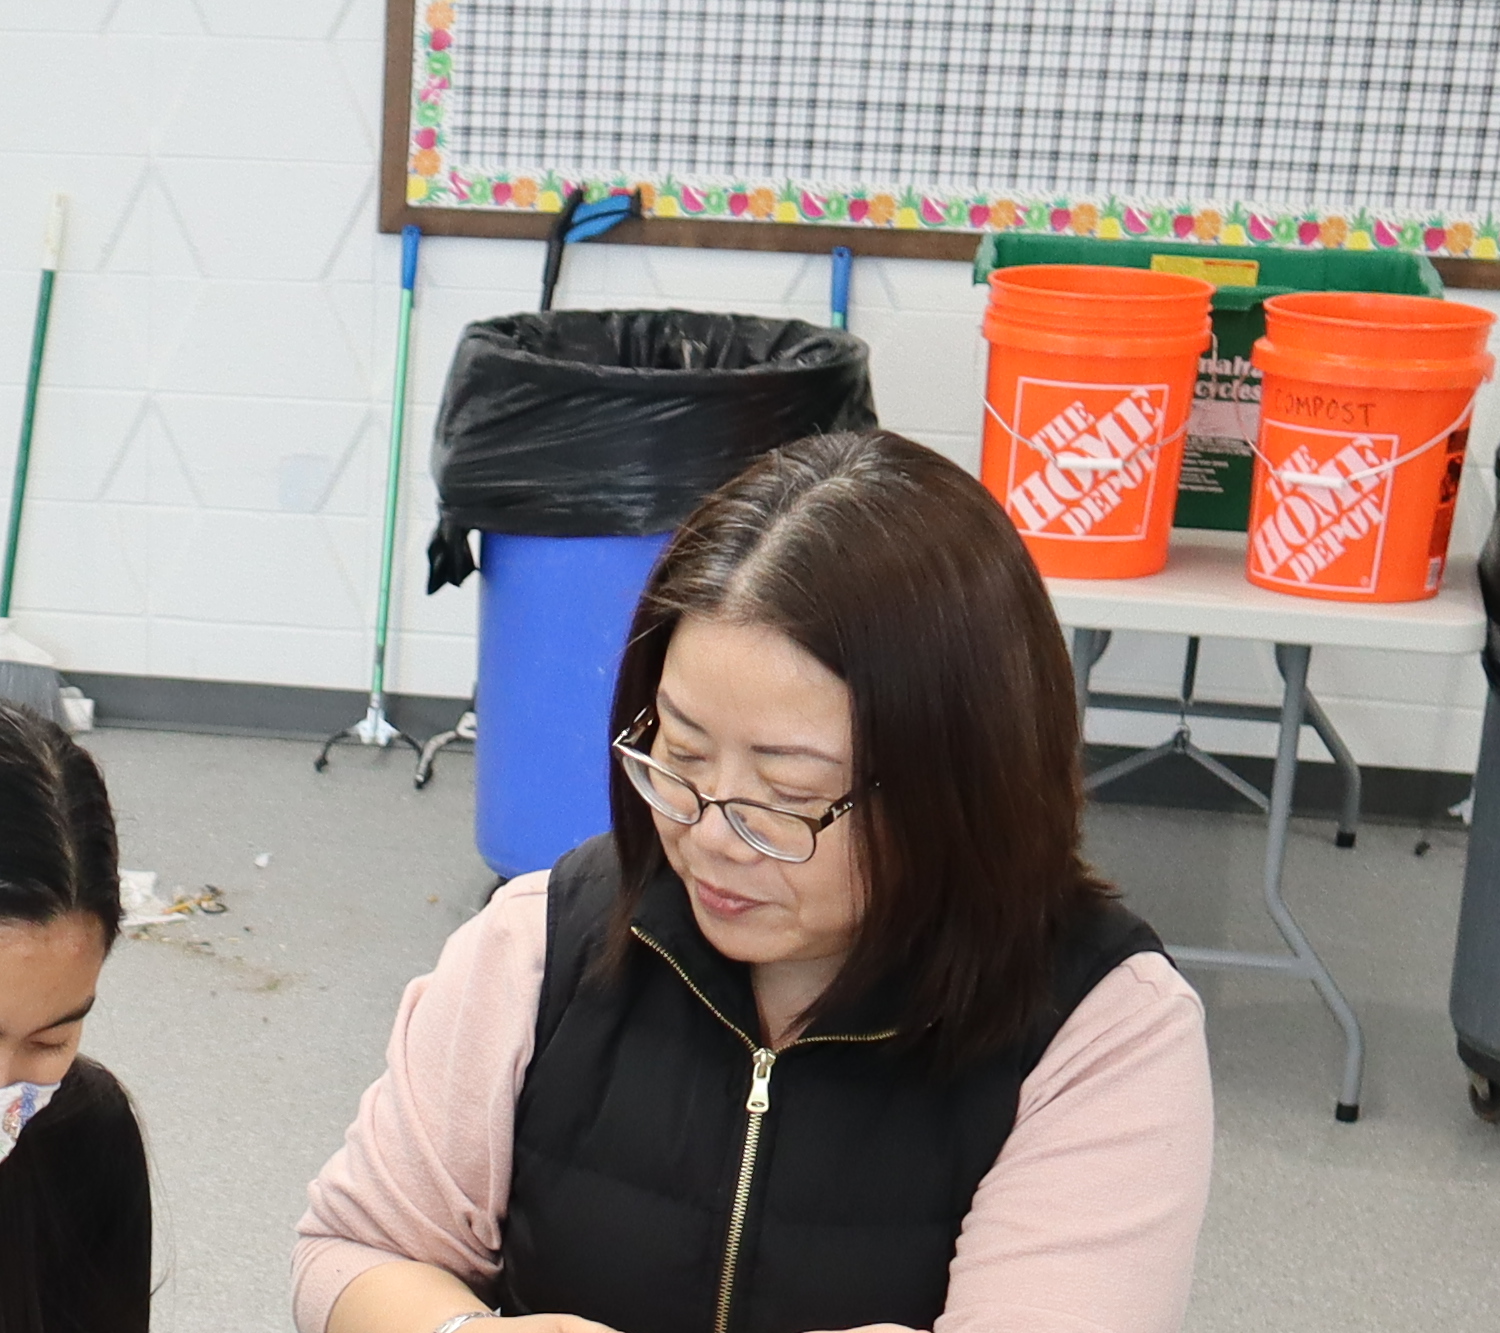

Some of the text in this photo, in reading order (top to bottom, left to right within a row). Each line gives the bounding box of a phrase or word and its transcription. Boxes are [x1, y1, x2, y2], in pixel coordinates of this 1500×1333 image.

[1194, 379, 1262, 401] cycles
[1274, 388, 1377, 428] COMPOST
[1010, 387, 1163, 531] HOME
[1030, 401, 1096, 460] THE
[1061, 443, 1156, 536] DEPOT
[1253, 434, 1390, 575] HOME
[1267, 444, 1318, 501] THE
[1288, 493, 1384, 584] DEPOT
